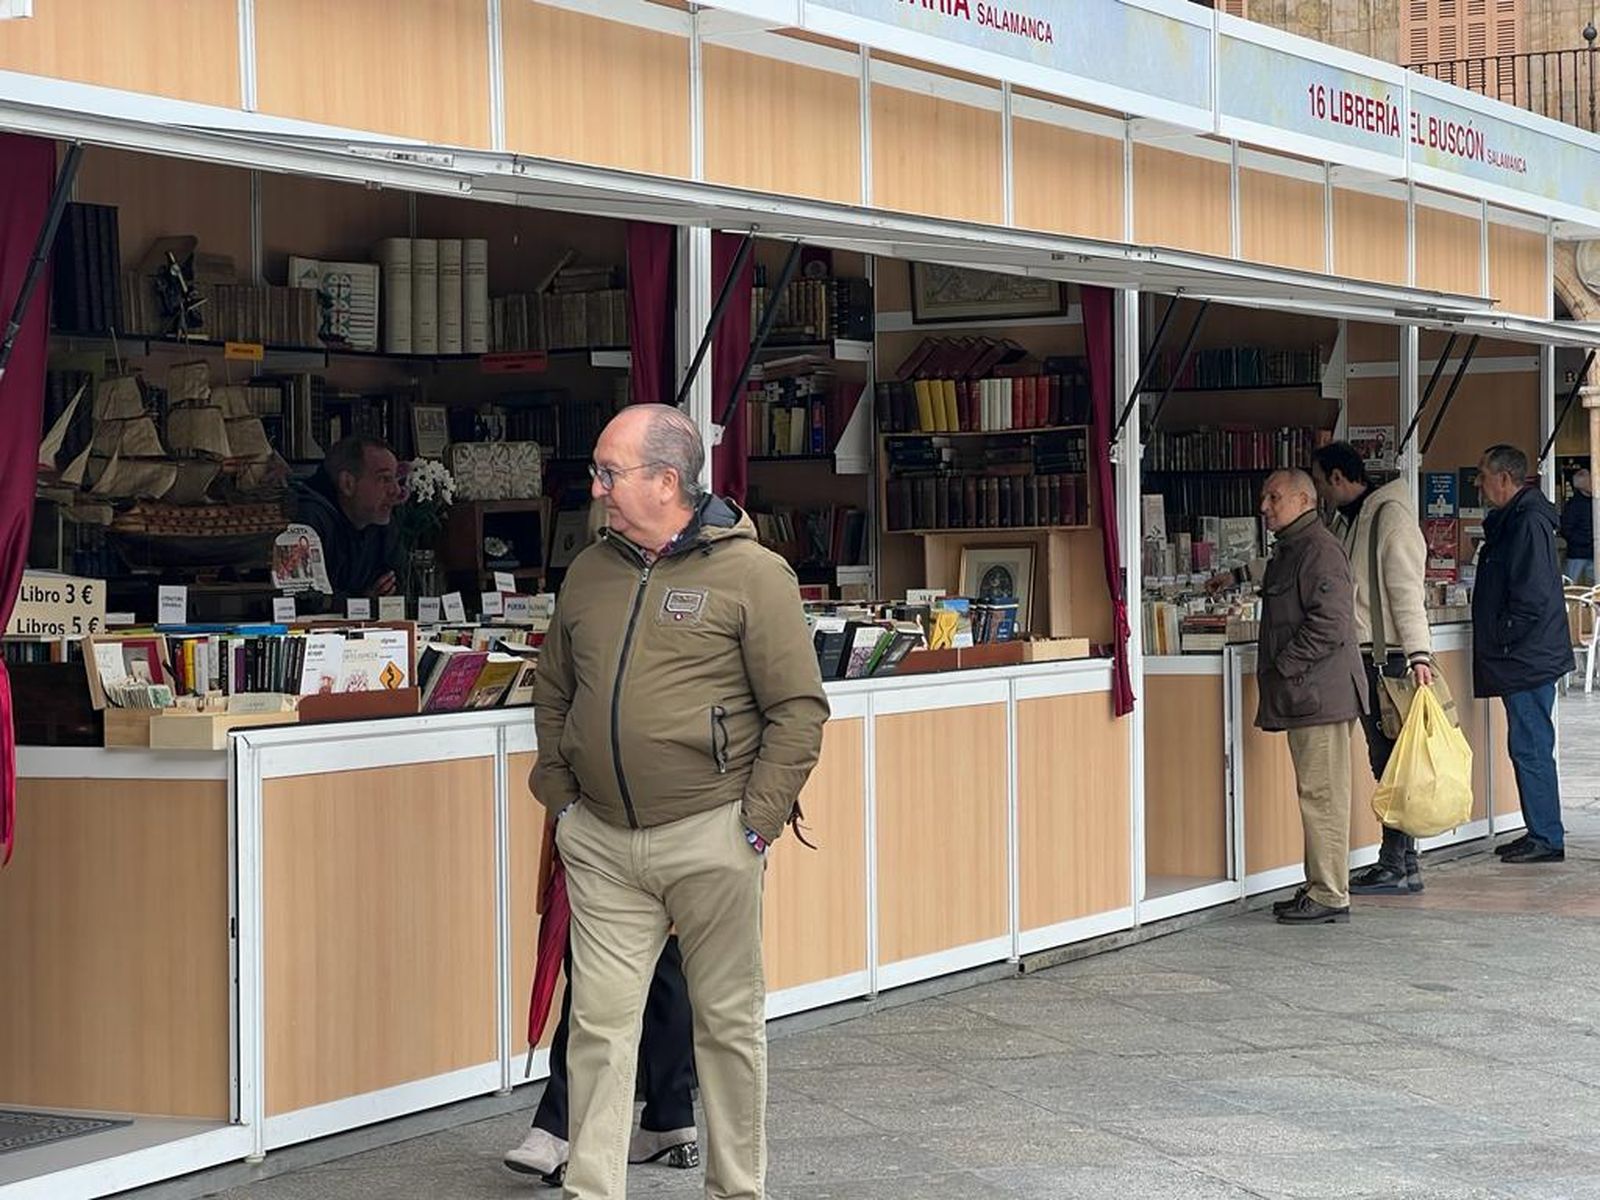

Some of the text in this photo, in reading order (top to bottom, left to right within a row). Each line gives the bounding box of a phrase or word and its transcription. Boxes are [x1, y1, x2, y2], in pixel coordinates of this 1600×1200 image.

[977, 3, 1054, 44] SALAMANCA
[1308, 83, 1326, 119] 16
[1330, 88, 1401, 138] LIBRERÍA
[1429, 116, 1485, 162] BUSCÓN
[1487, 149, 1528, 174] SALAMANCA
[20, 583, 93, 605] Libro 3 €
[16, 616, 100, 635] Libros 5 €
